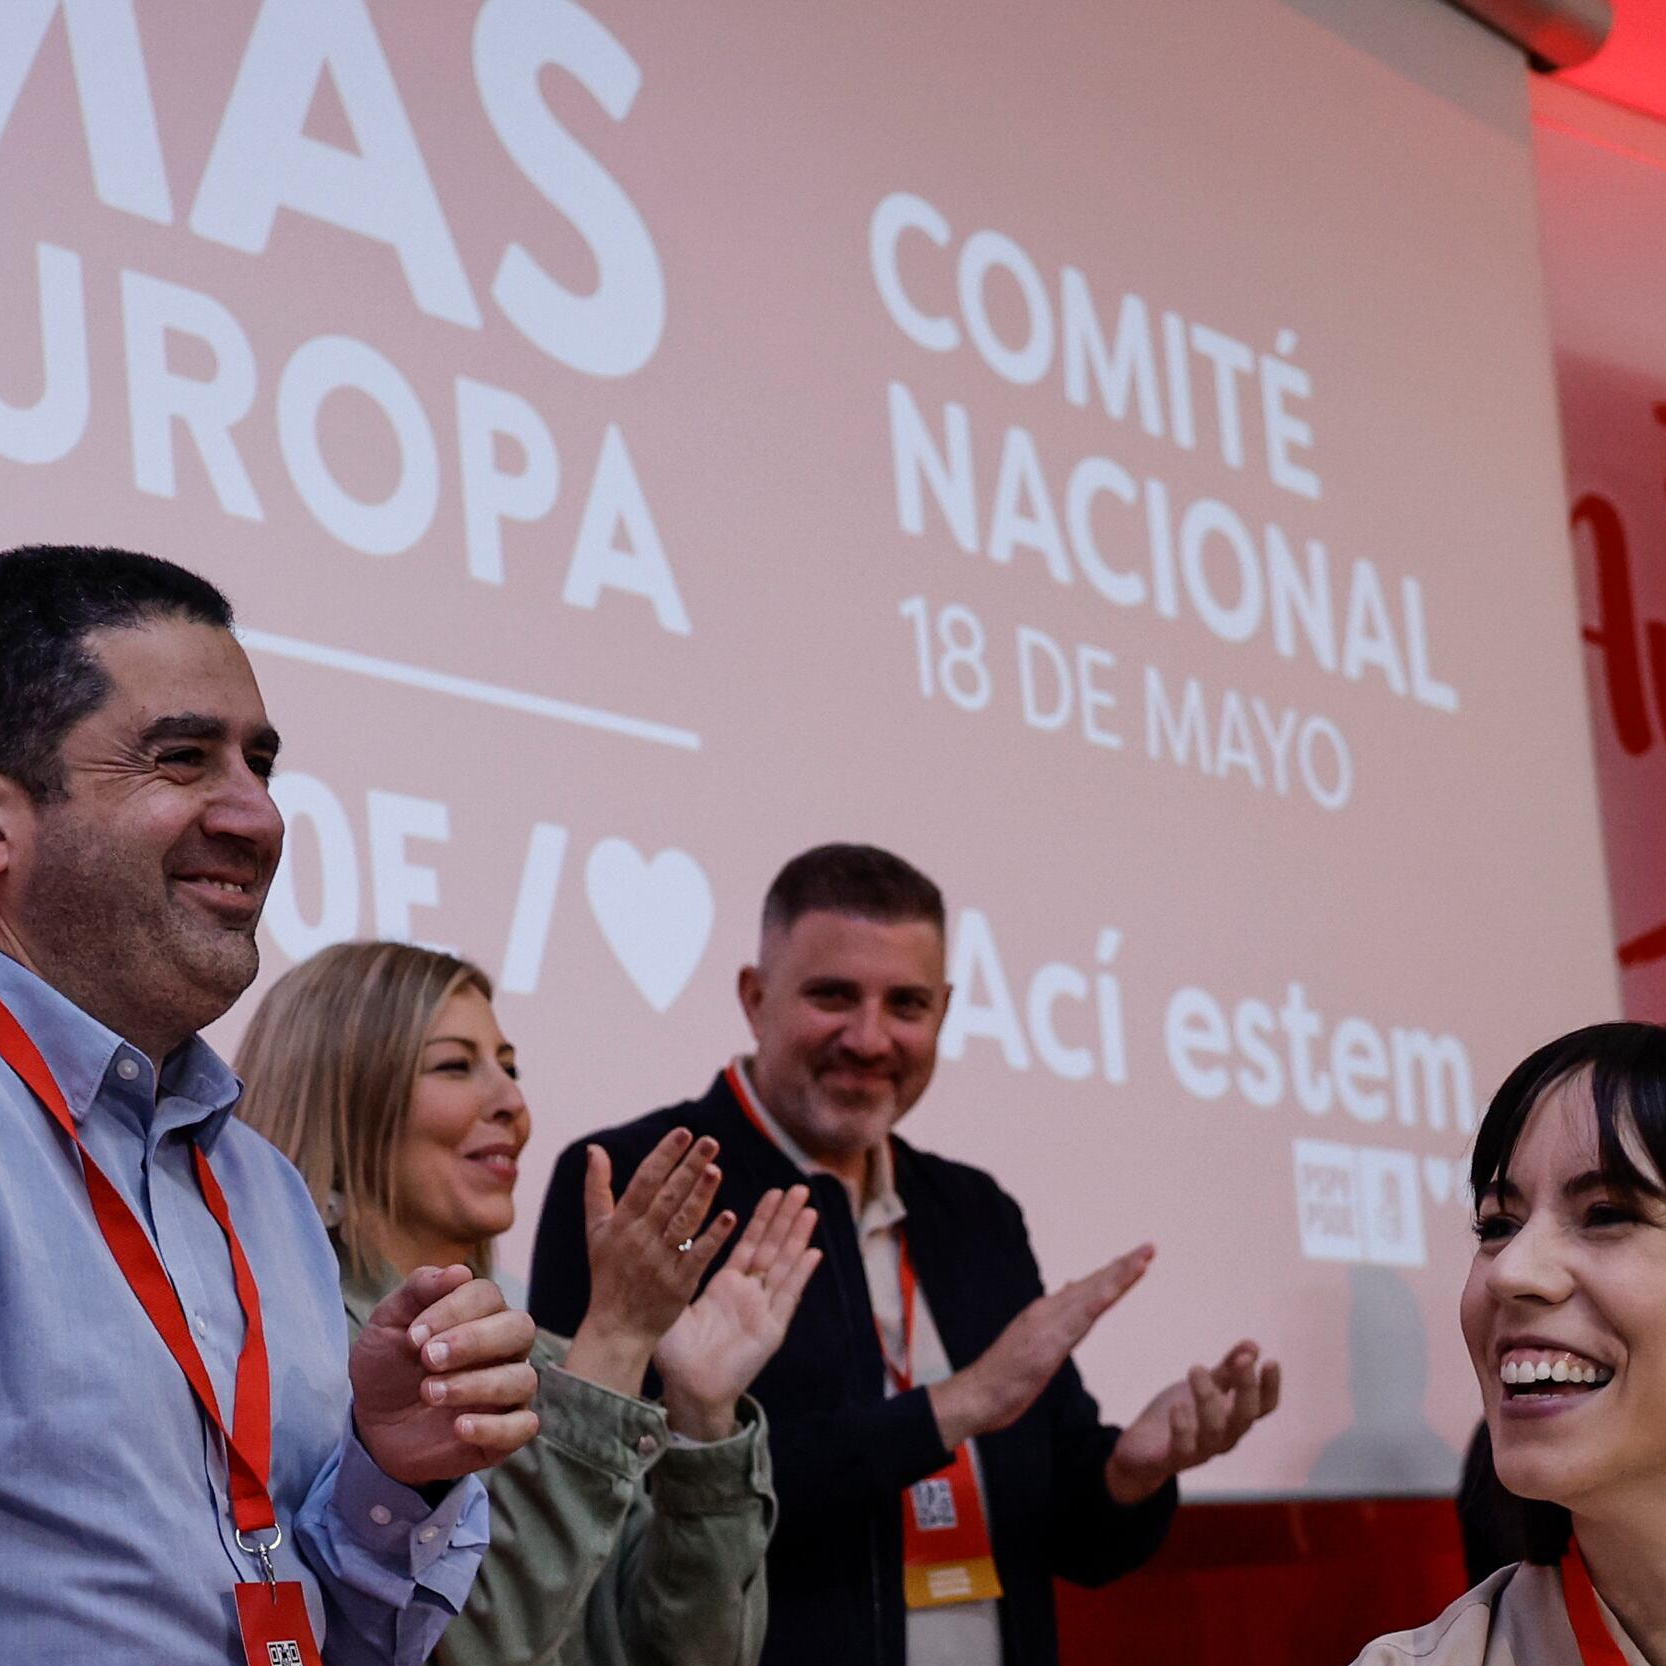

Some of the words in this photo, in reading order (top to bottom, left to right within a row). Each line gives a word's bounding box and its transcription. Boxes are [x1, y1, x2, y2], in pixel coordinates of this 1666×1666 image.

[868, 190, 1322, 500] COMITÉ
[887, 379, 1460, 713] NACIONAL
[899, 594, 993, 711] 18
[1015, 625, 1123, 749] DE
[1143, 666, 1354, 811] MAYO
[938, 907, 1128, 1085] Ací
[1163, 982, 1478, 1135] estem
